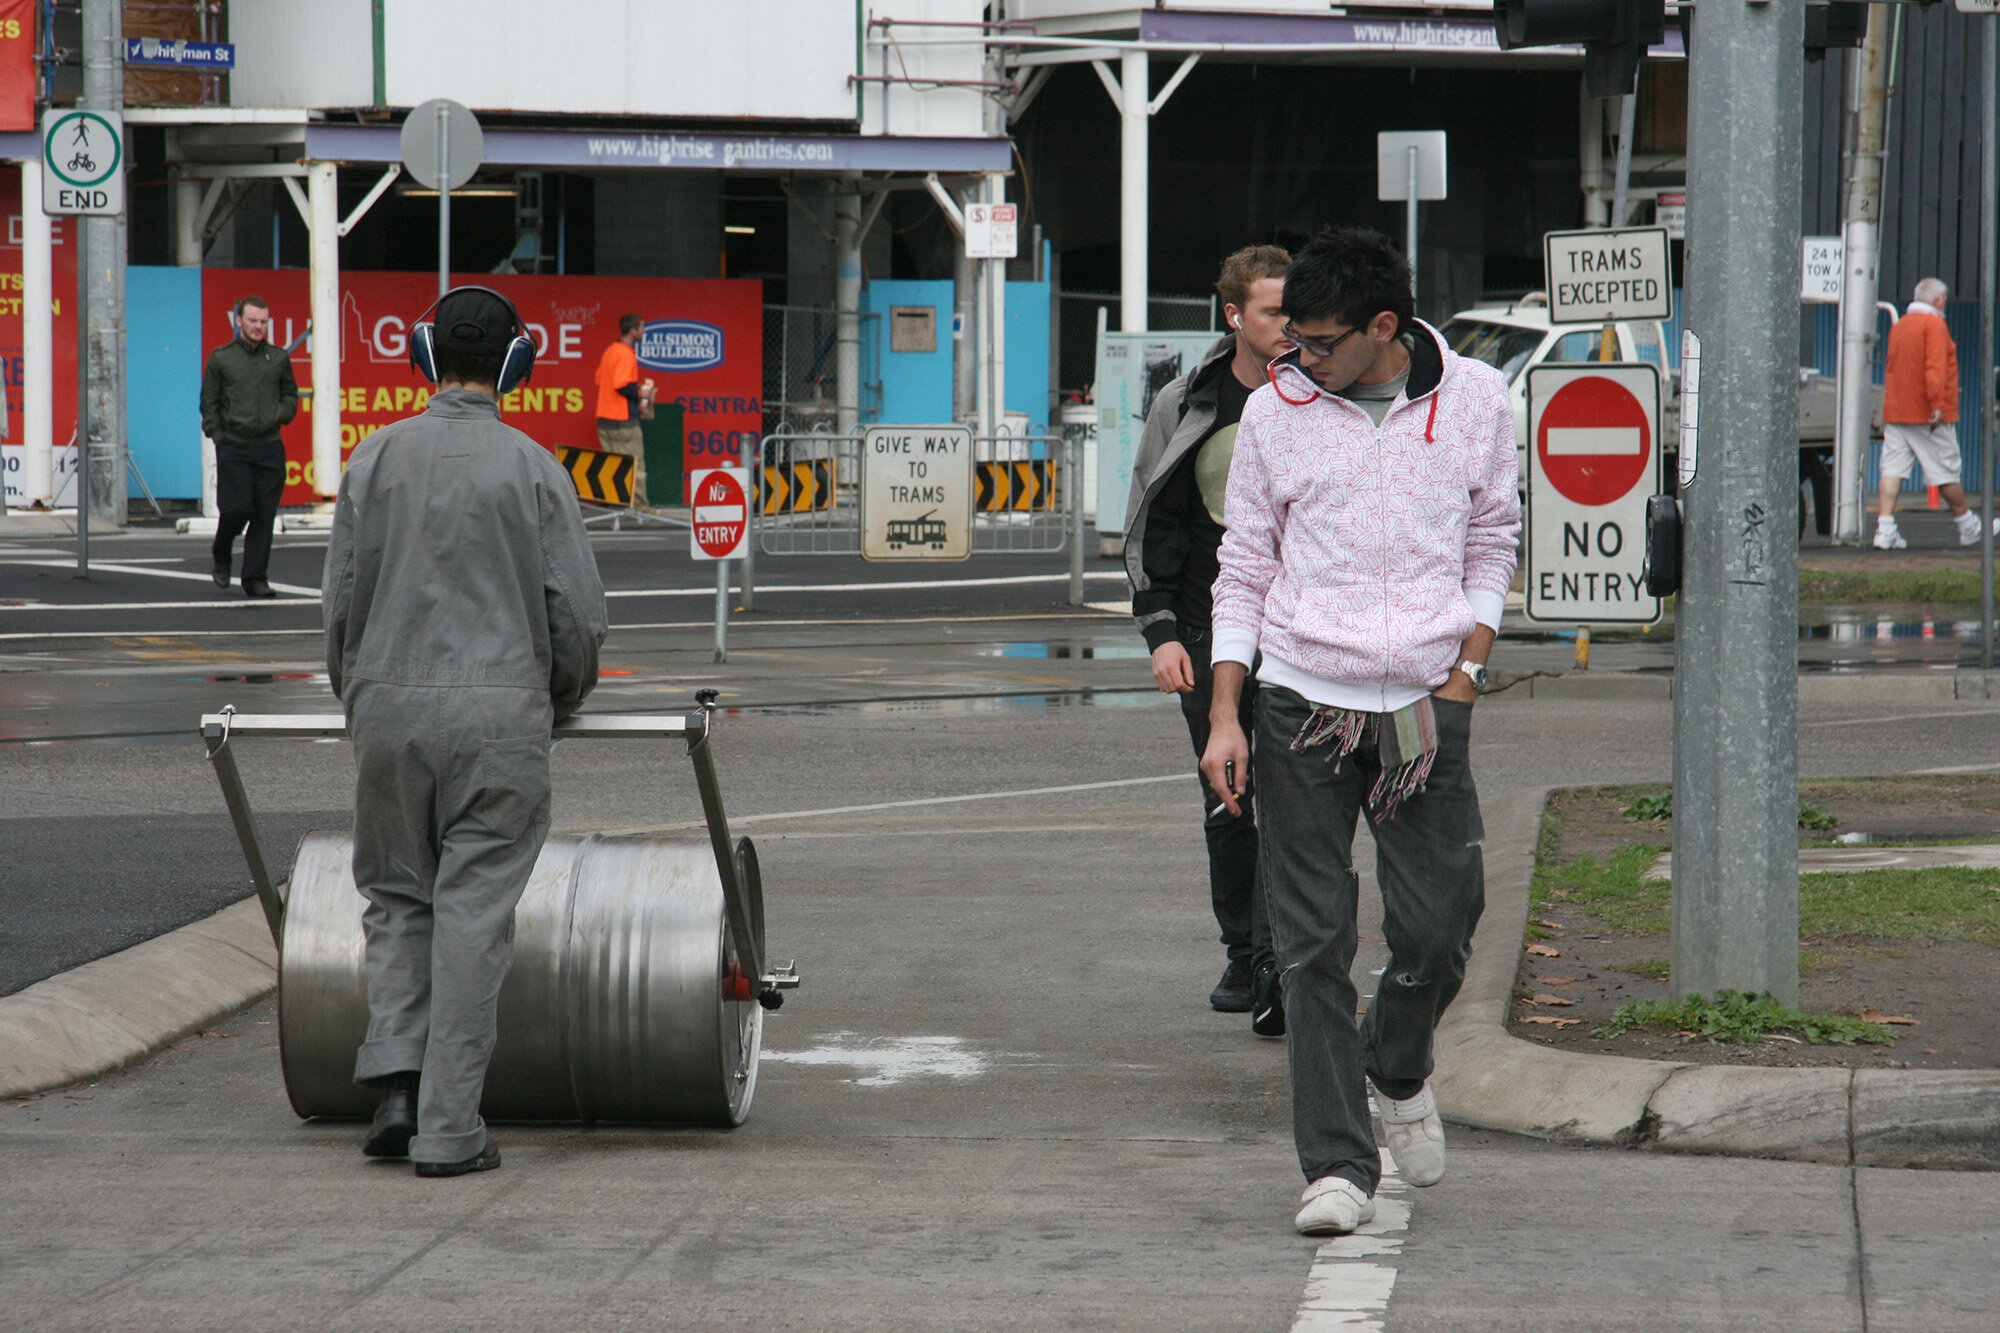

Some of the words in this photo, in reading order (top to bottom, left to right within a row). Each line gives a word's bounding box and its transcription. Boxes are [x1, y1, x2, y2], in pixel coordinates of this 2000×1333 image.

[214, 47, 230, 62] St
[59, 190, 108, 208] END
[1567, 247, 1642, 273] TRAMS
[1812, 248, 1828, 260] 24
[1807, 264, 1831, 277] TOW
[1558, 279, 1658, 305] EXCEPTED
[1822, 281, 1839, 293] ZO
[641, 345, 716, 359] BUILDERS
[372, 386, 585, 413] APAENTS
[875, 437, 911, 453] GIVE
[924, 437, 960, 453] WAY
[908, 461, 927, 478] TO
[710, 484, 727, 502] NO
[890, 486, 944, 503] TRAMS
[699, 526, 737, 544] ENTRY
[1564, 521, 1623, 557] NO
[1540, 572, 1646, 601] ENTRY
